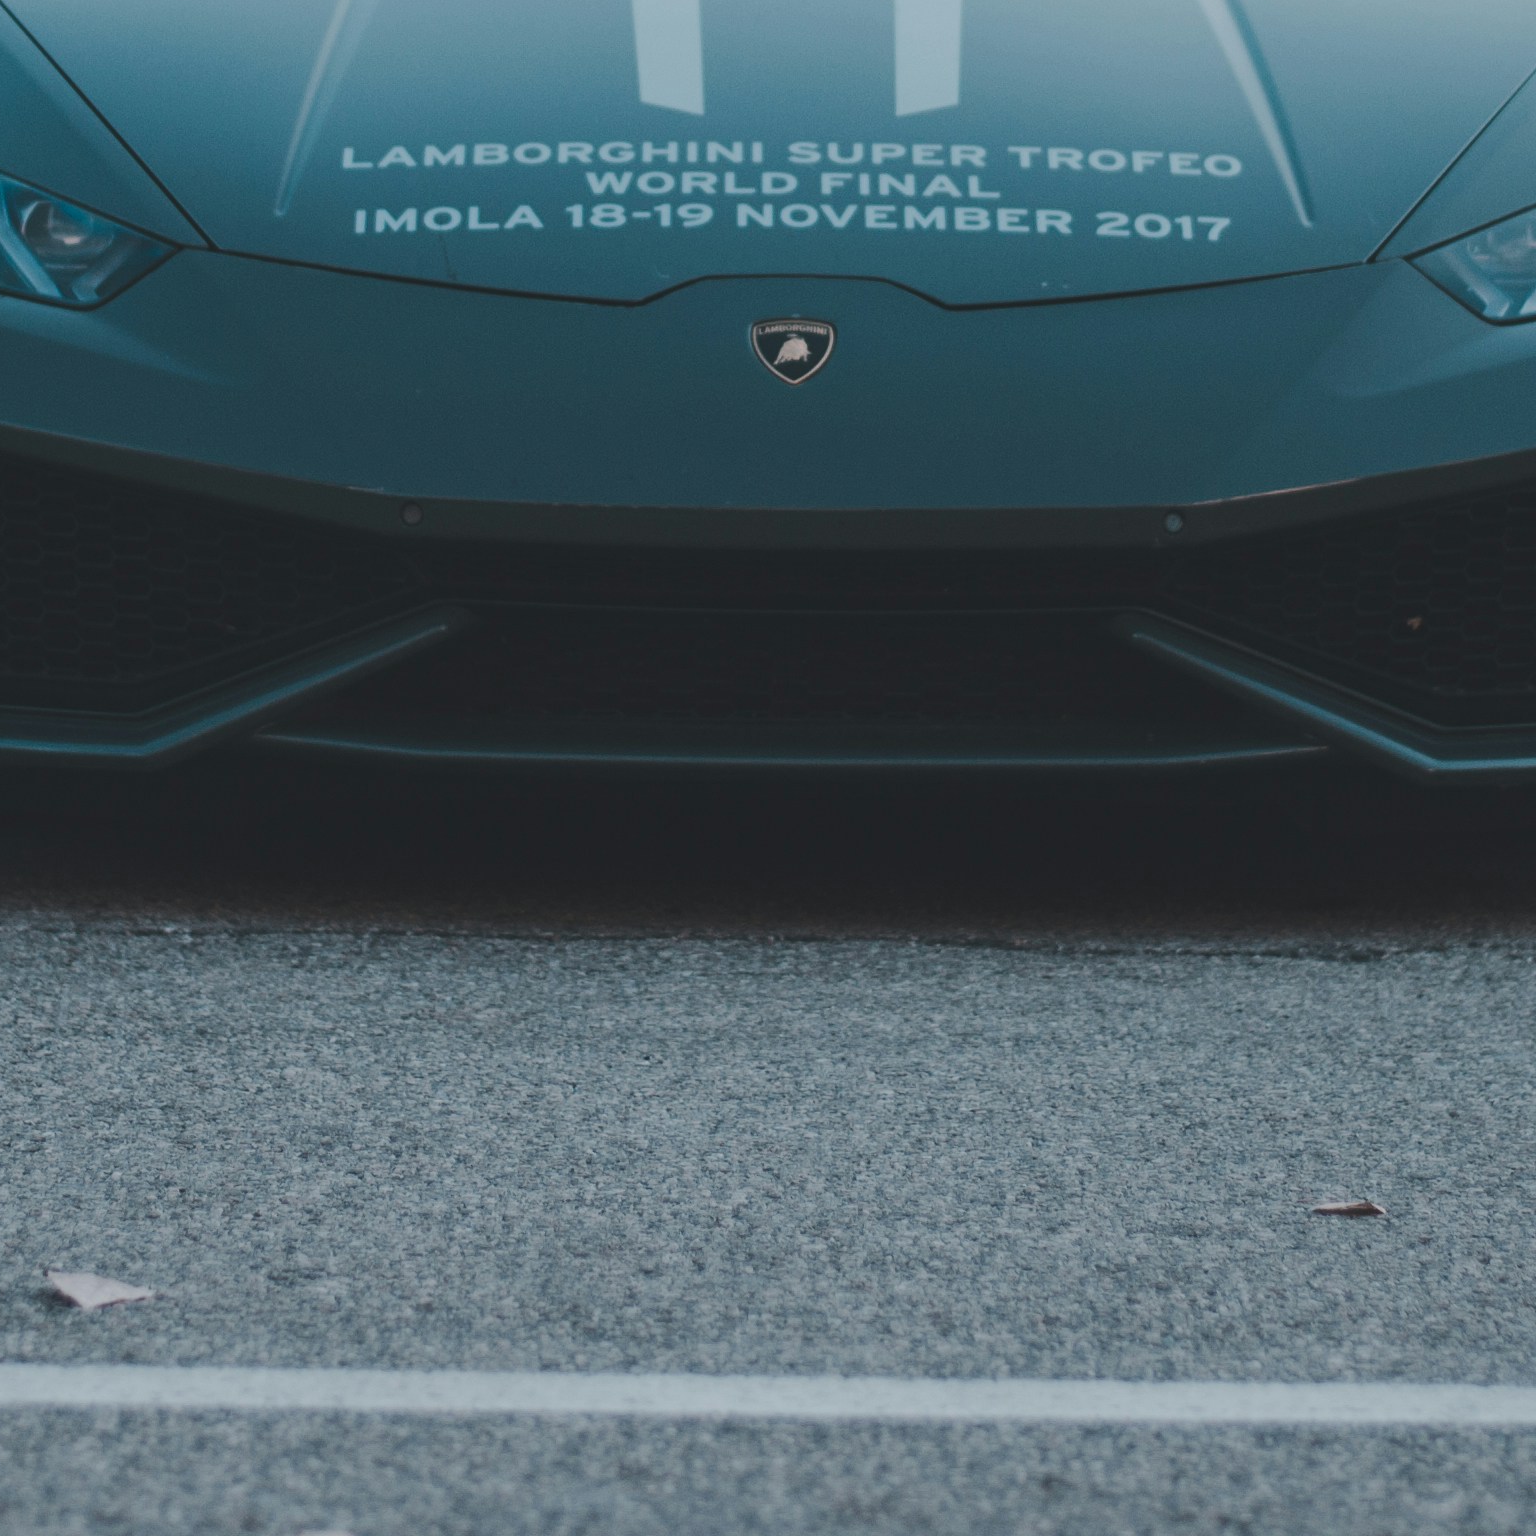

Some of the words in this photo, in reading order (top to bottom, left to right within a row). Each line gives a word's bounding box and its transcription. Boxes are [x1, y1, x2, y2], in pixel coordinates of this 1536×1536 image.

[342, 140, 763, 169] LAMBORGHINI
[787, 141, 988, 167] SUPER
[1006, 145, 1243, 178] TROFEO
[584, 170, 799, 196] WORLD
[819, 172, 1002, 199] FINAL
[353, 204, 545, 234] IMOLA
[564, 202, 715, 229] 18-19
[735, 202, 1074, 235] NOVEMBER
[1094, 210, 1232, 241] 2017
[758, 323, 828, 336] LAMBORGHINI
